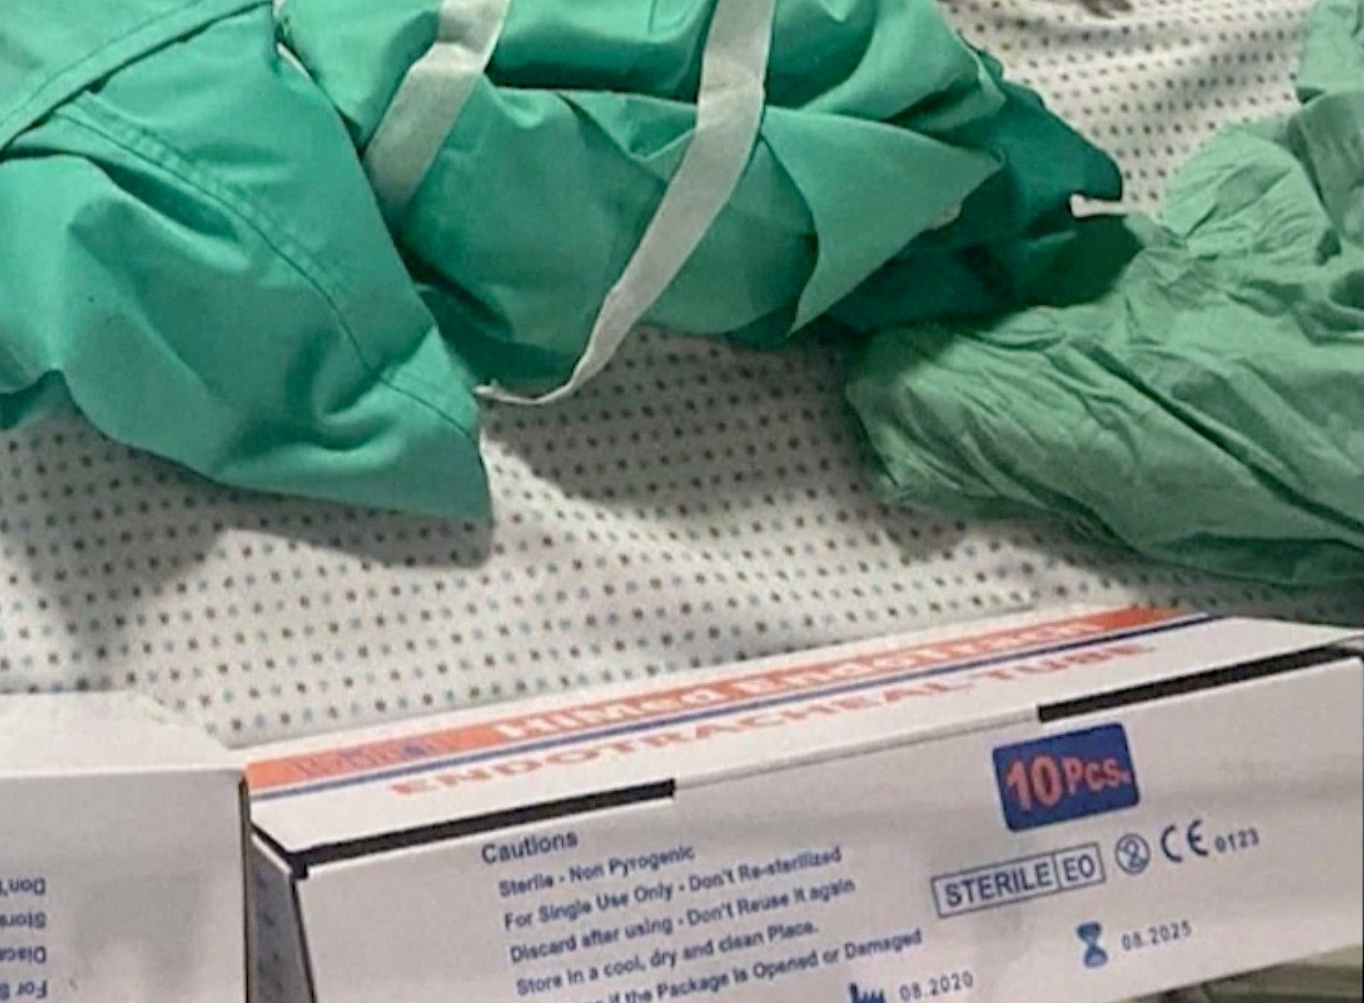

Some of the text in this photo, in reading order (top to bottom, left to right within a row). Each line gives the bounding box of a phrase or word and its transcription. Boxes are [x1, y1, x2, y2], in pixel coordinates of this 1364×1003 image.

[391, 681, 976, 795] ENDOTRACHEAL
[481, 832, 578, 865] Cautions
[499, 874, 554, 897] Sterile
[569, 862, 604, 883] Non
[608, 845, 695, 876] Pyrogenic
[944, 865, 1055, 907] STERILE
[1062, 853, 1097, 883] EO
[1214, 828, 1259, 855] 0123
[505, 912, 533, 931] For
[539, 900, 592, 922] Single
[596, 892, 630, 911] Use
[633, 883, 673, 903] Only
[689, 870, 735, 892] Don't
[737, 846, 842, 881] Re-sterilized
[510, 934, 577, 963] Discard
[582, 927, 619, 948] after
[625, 918, 673, 939] using
[687, 903, 734, 926] Don't
[737, 894, 788, 915] Reuse
[793, 887, 805, 902] it
[810, 877, 856, 903] again
[516, 921, 819, 996] Store in a cool, dry and clean Place.
[609, 927, 922, 1003] if the Package is Opened or Damaged
[1121, 920, 1192, 952] 08.2025
[17, 980, 48, 1000] For
[899, 971, 973, 1002] 08.2020
